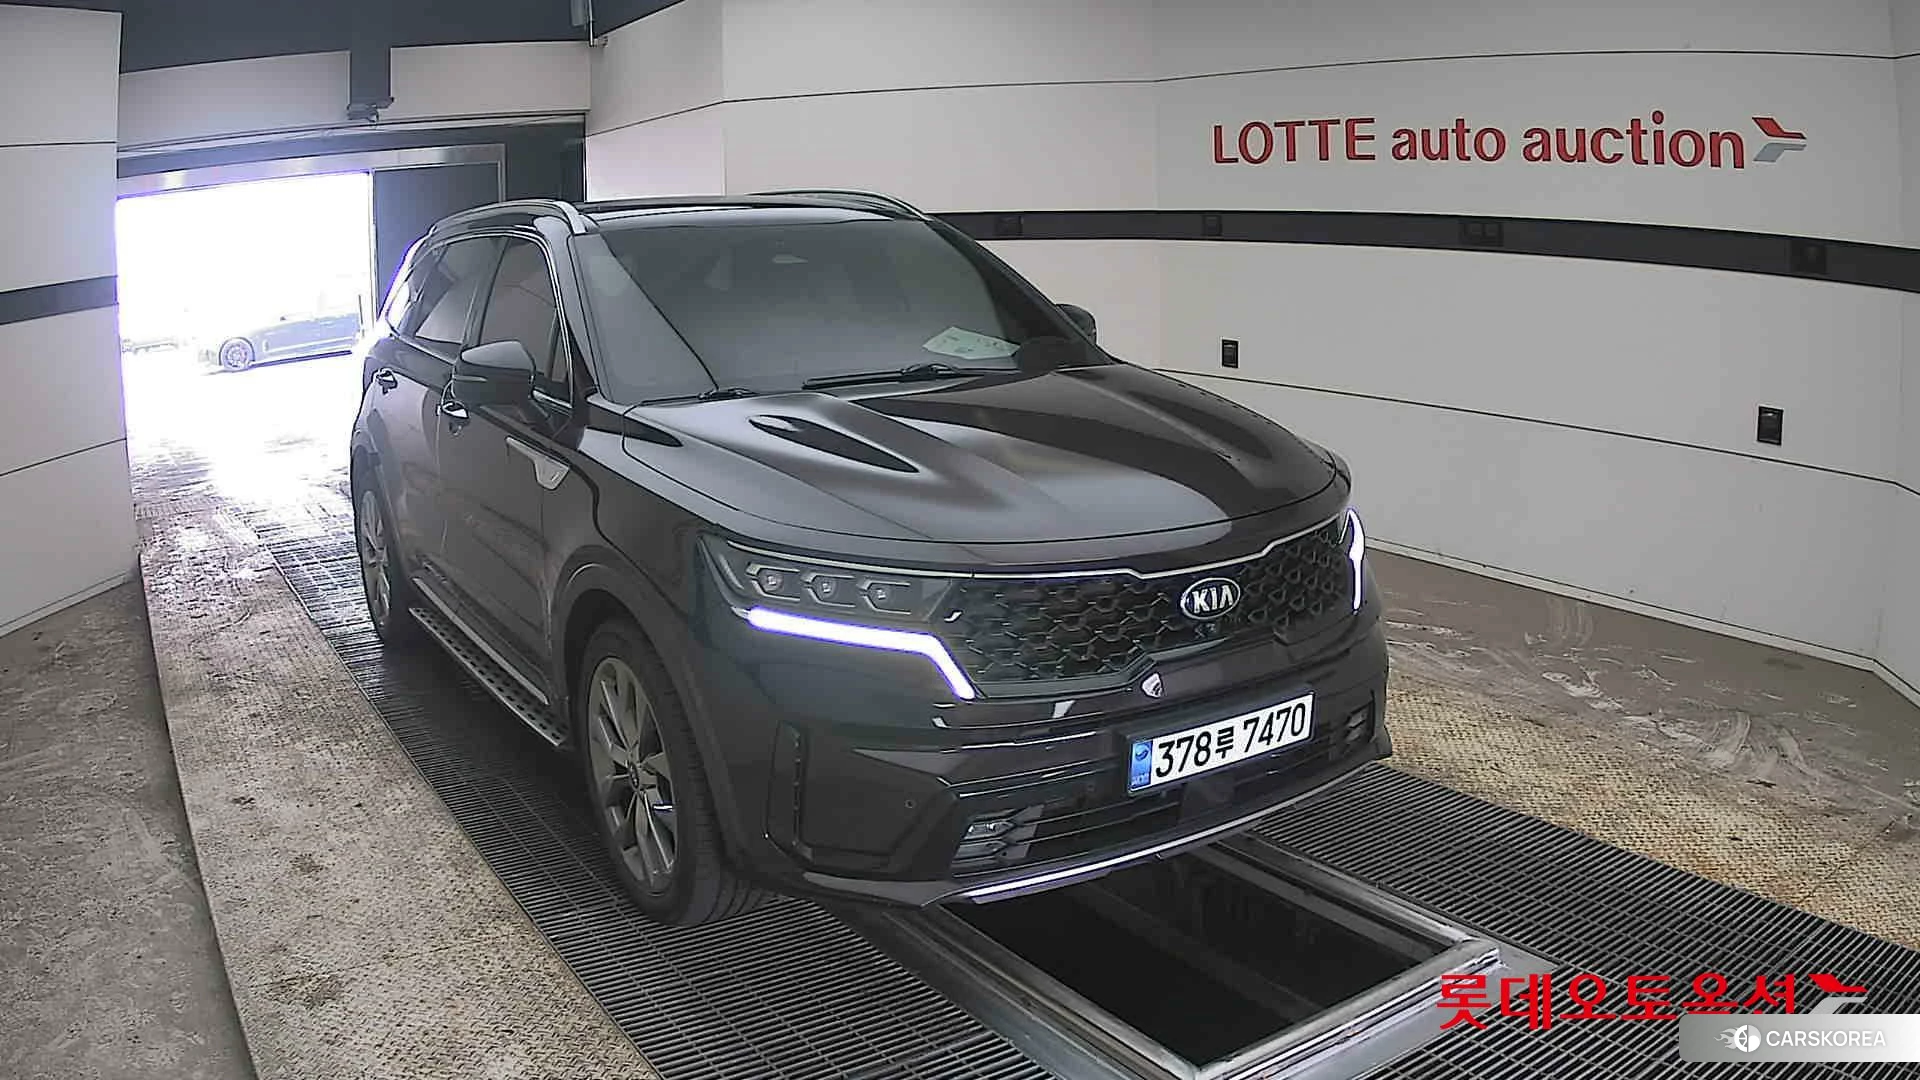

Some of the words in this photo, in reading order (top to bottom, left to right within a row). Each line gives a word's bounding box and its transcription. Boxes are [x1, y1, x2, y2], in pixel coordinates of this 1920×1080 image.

[1213, 118, 1376, 164] LOTTE
[1391, 118, 1506, 161] auto
[1522, 111, 1746, 169] auction
[1193, 585, 1234, 613] KIA
[1155, 726, 1235, 778] 378루
[1243, 702, 1306, 753] 7470
